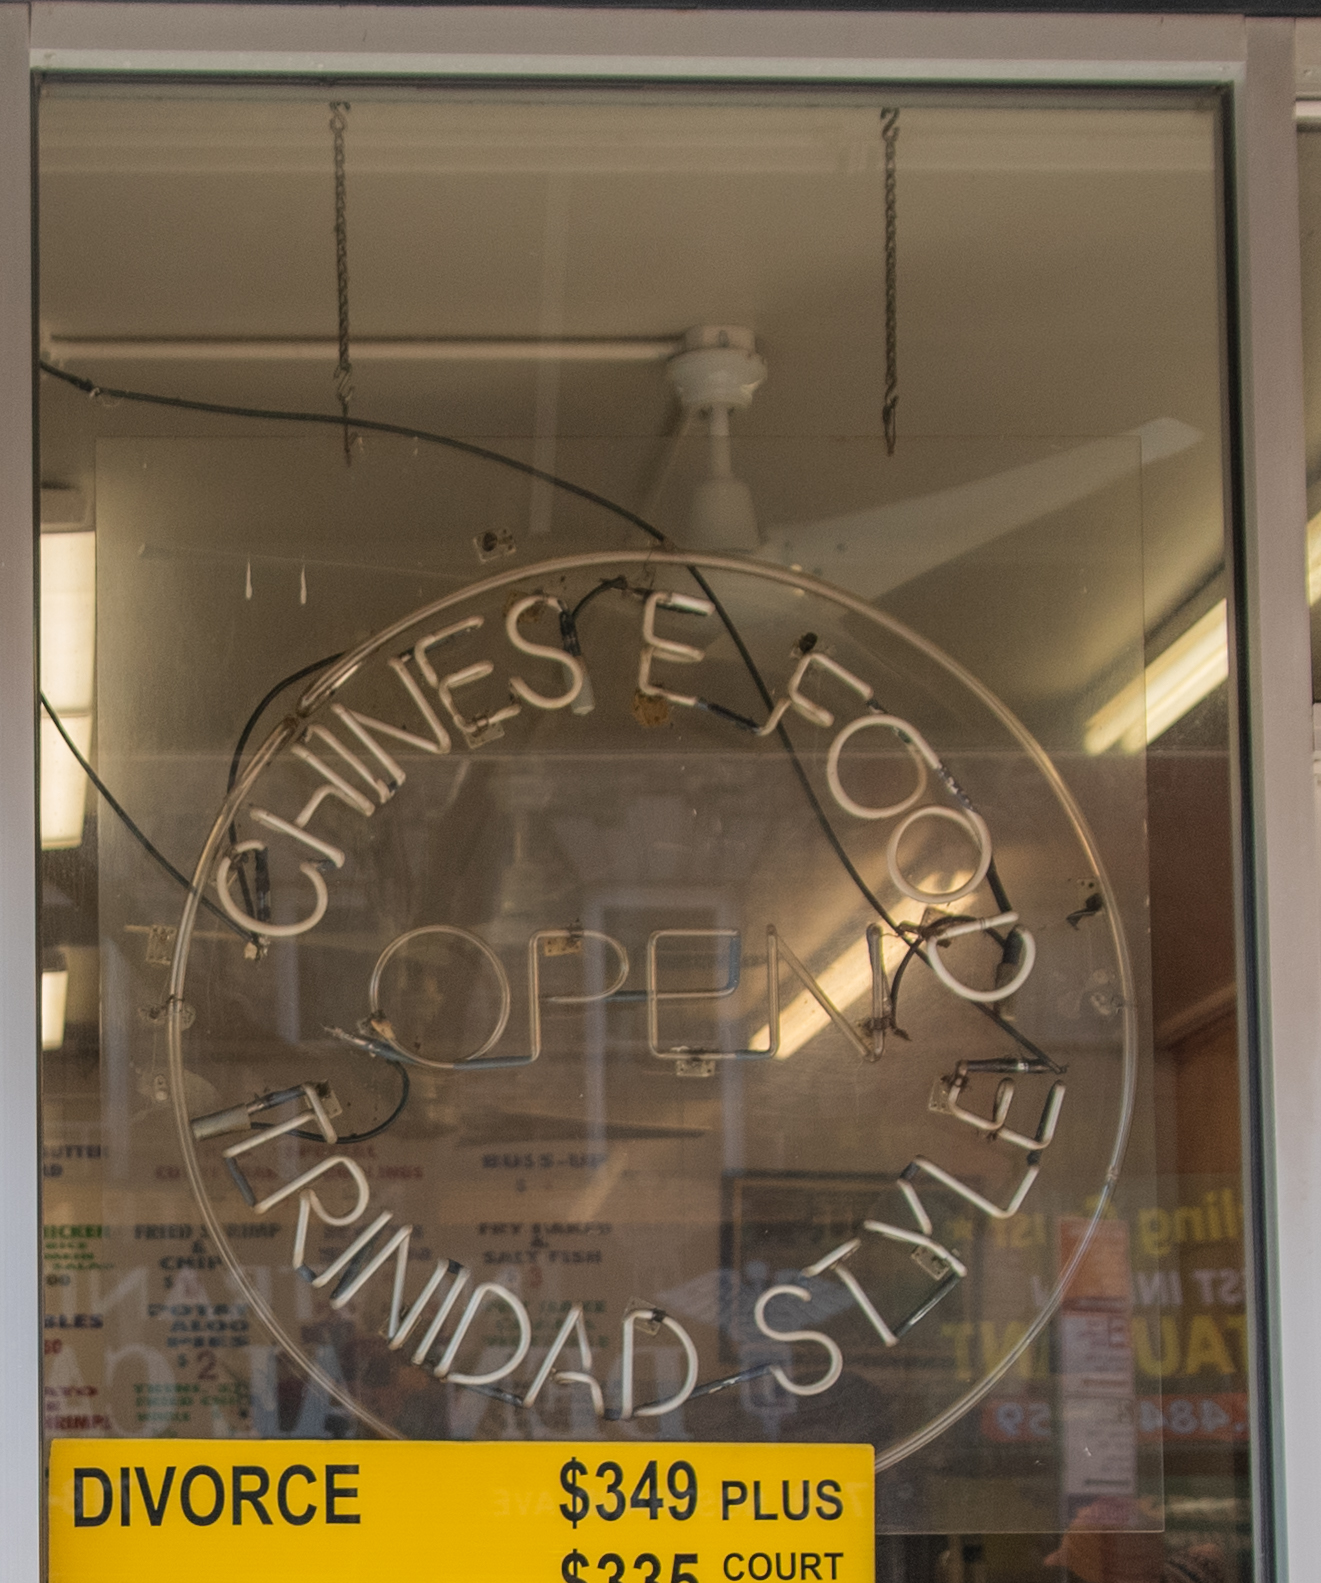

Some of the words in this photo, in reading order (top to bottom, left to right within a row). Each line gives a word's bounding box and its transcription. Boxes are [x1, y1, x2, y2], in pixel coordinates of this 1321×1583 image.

[760, 650, 1037, 1001] FOOD
[370, 923, 887, 1069] OPEN
[222, 1080, 698, 1421] TRINIDAD
[753, 1060, 1068, 1396] STYLE
[73, 1464, 361, 1528] DIVORCE
[559, 1456, 698, 1530] $349
[721, 1479, 843, 1521] PLUS
[723, 1552, 844, 1582] COURT
